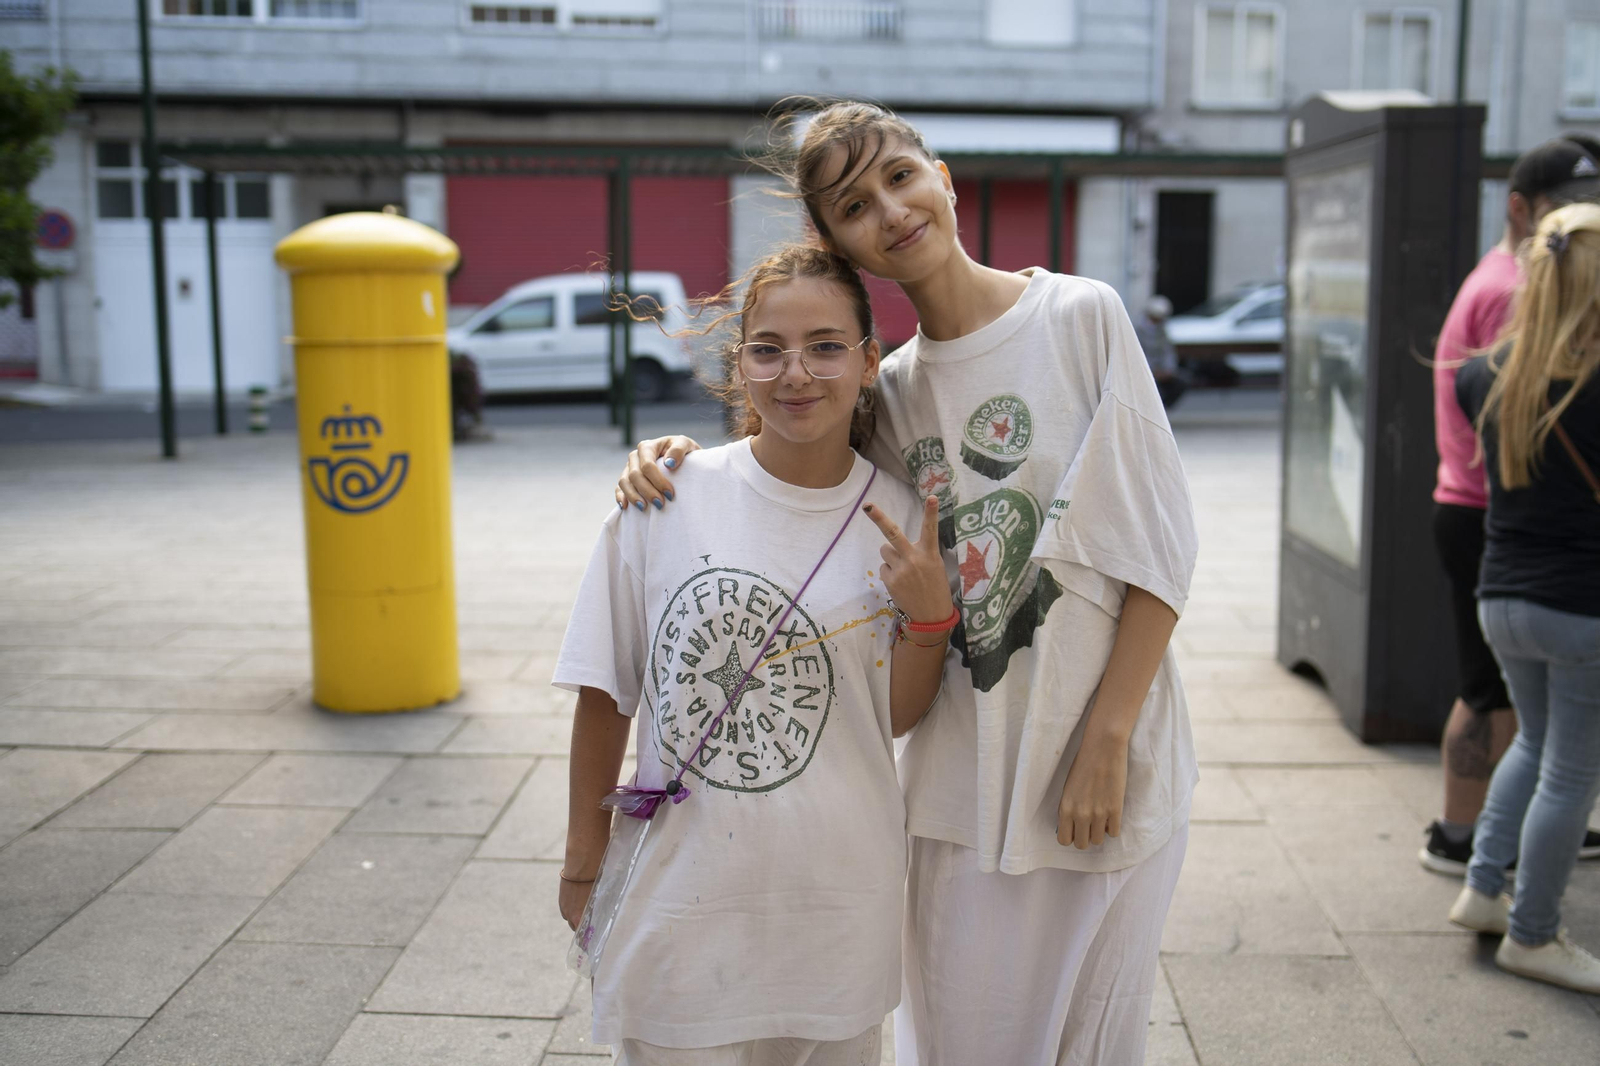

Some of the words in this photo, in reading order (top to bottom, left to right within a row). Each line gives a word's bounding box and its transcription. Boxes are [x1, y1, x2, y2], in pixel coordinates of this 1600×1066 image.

[972, 400, 1019, 448] Heineken
[1002, 425, 1029, 454] Beer
[660, 620, 681, 725] SPAIN
[676, 618, 719, 686] SANT
